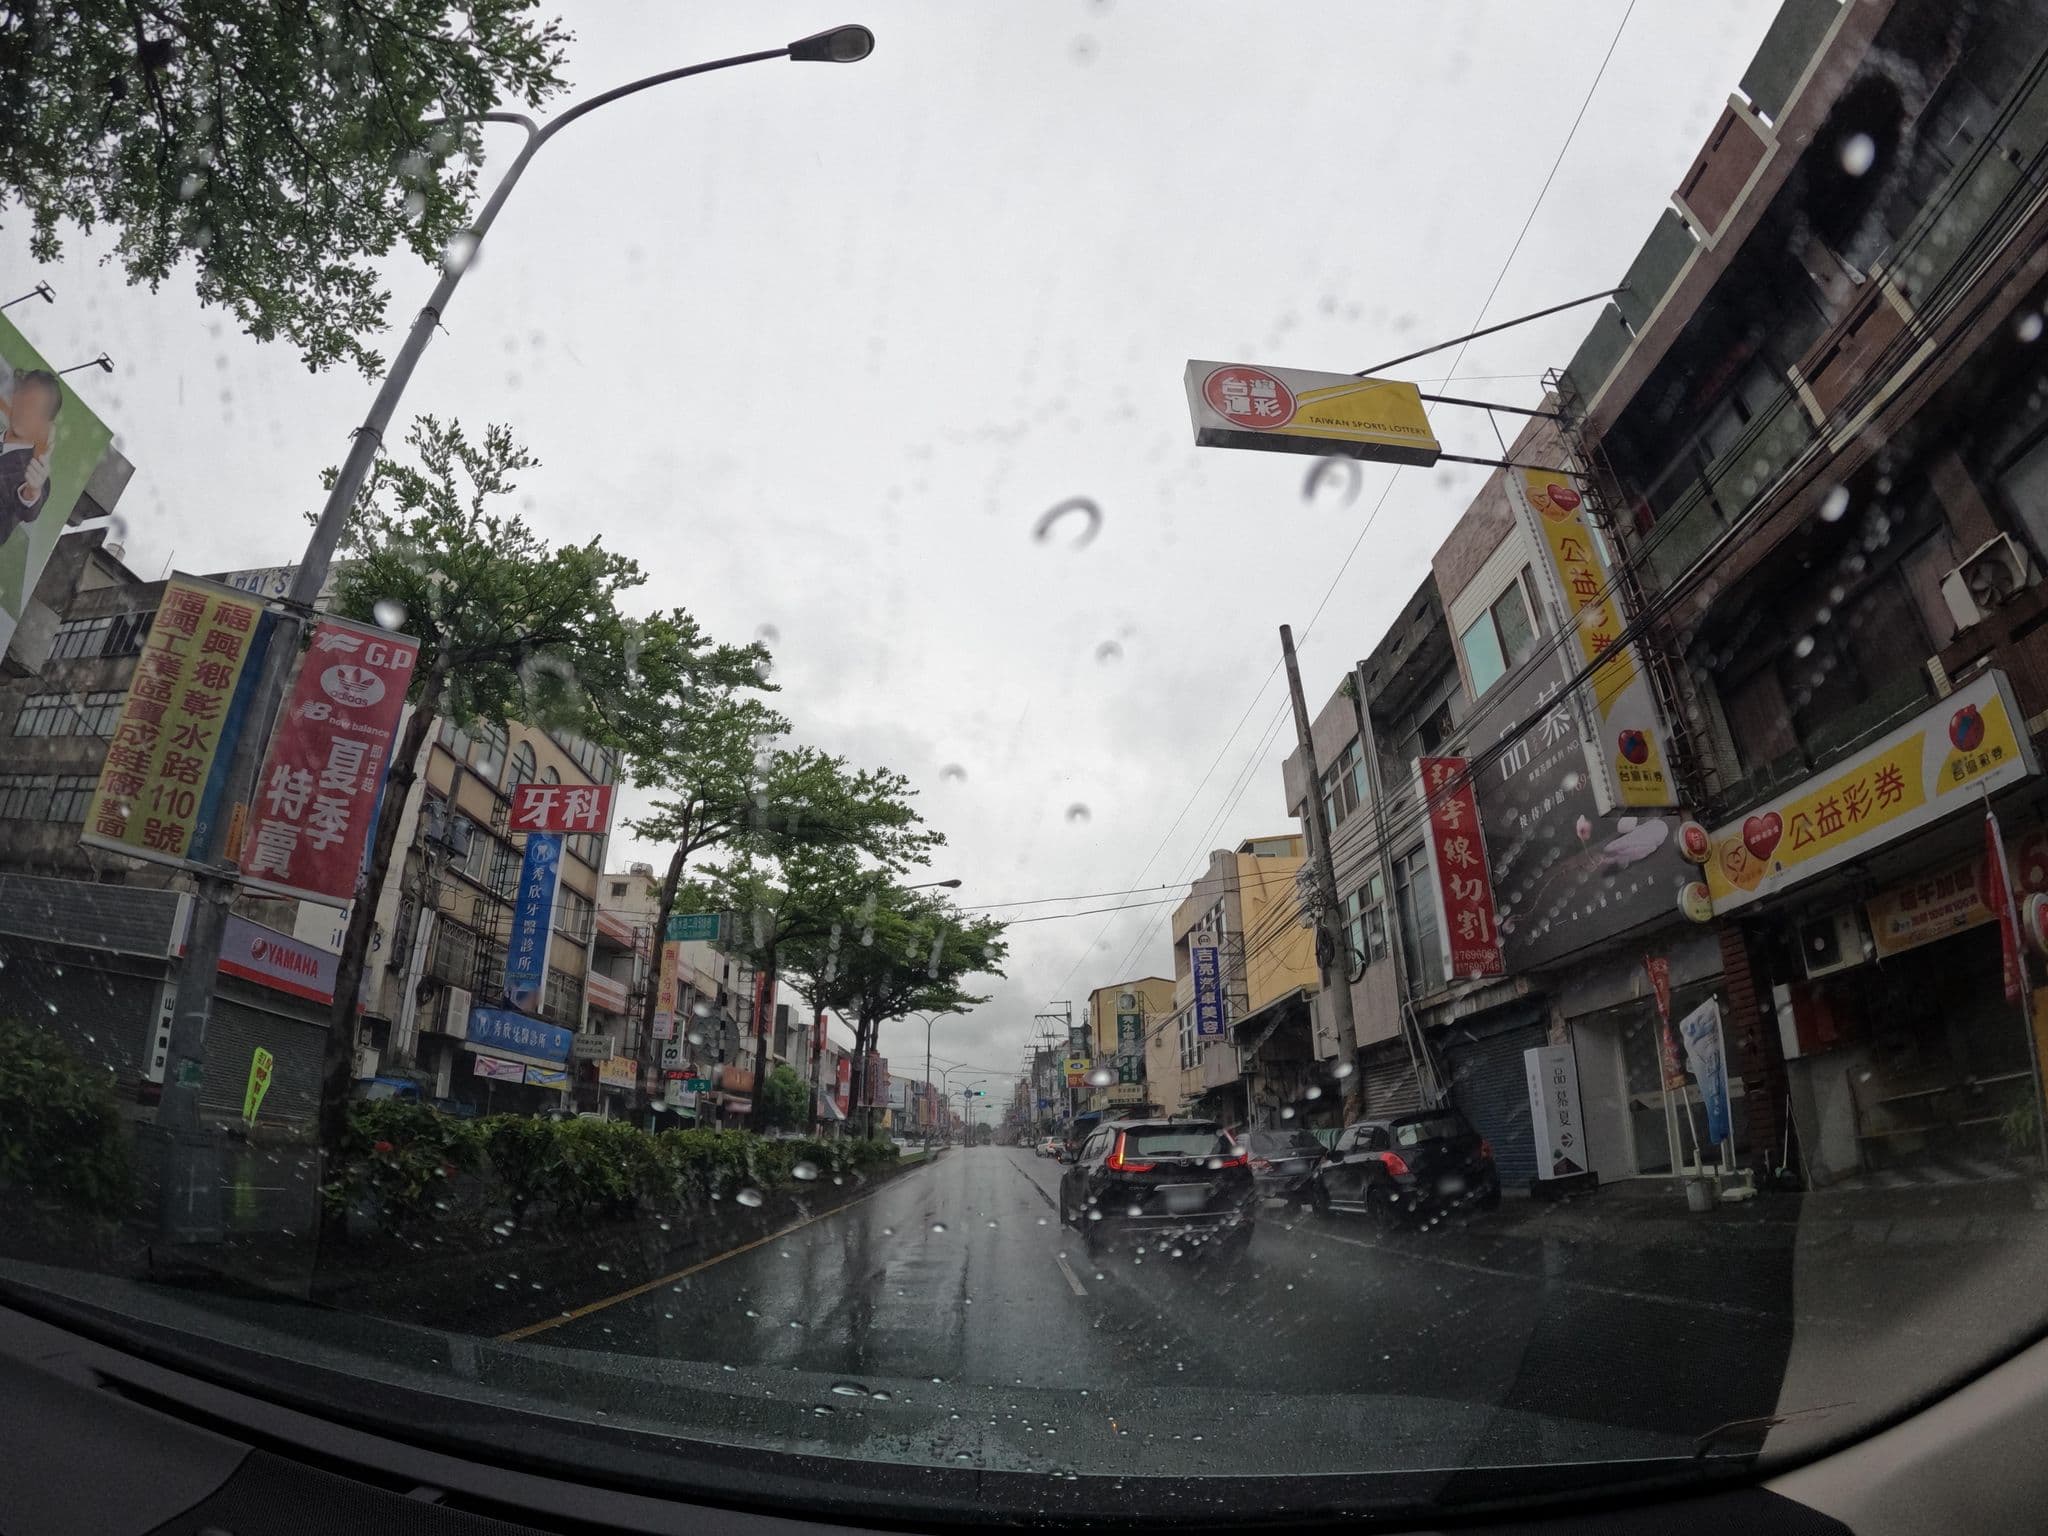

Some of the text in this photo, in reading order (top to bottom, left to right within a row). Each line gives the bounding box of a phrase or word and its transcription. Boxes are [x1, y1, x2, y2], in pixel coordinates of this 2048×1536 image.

[1309, 416, 1427, 436] TAIWAN SPORTS LOTTERY
[331, 689, 368, 706] adidas
[143, 600, 256, 854] 福興鄉彰水路110號
[352, 721, 390, 738] balance
[305, 736, 369, 850] 夏季
[519, 788, 601, 828] 牙科
[1789, 763, 1905, 850] 公益彩券
[248, 764, 313, 879] 特賣
[266, 943, 319, 978] YAMAHA
